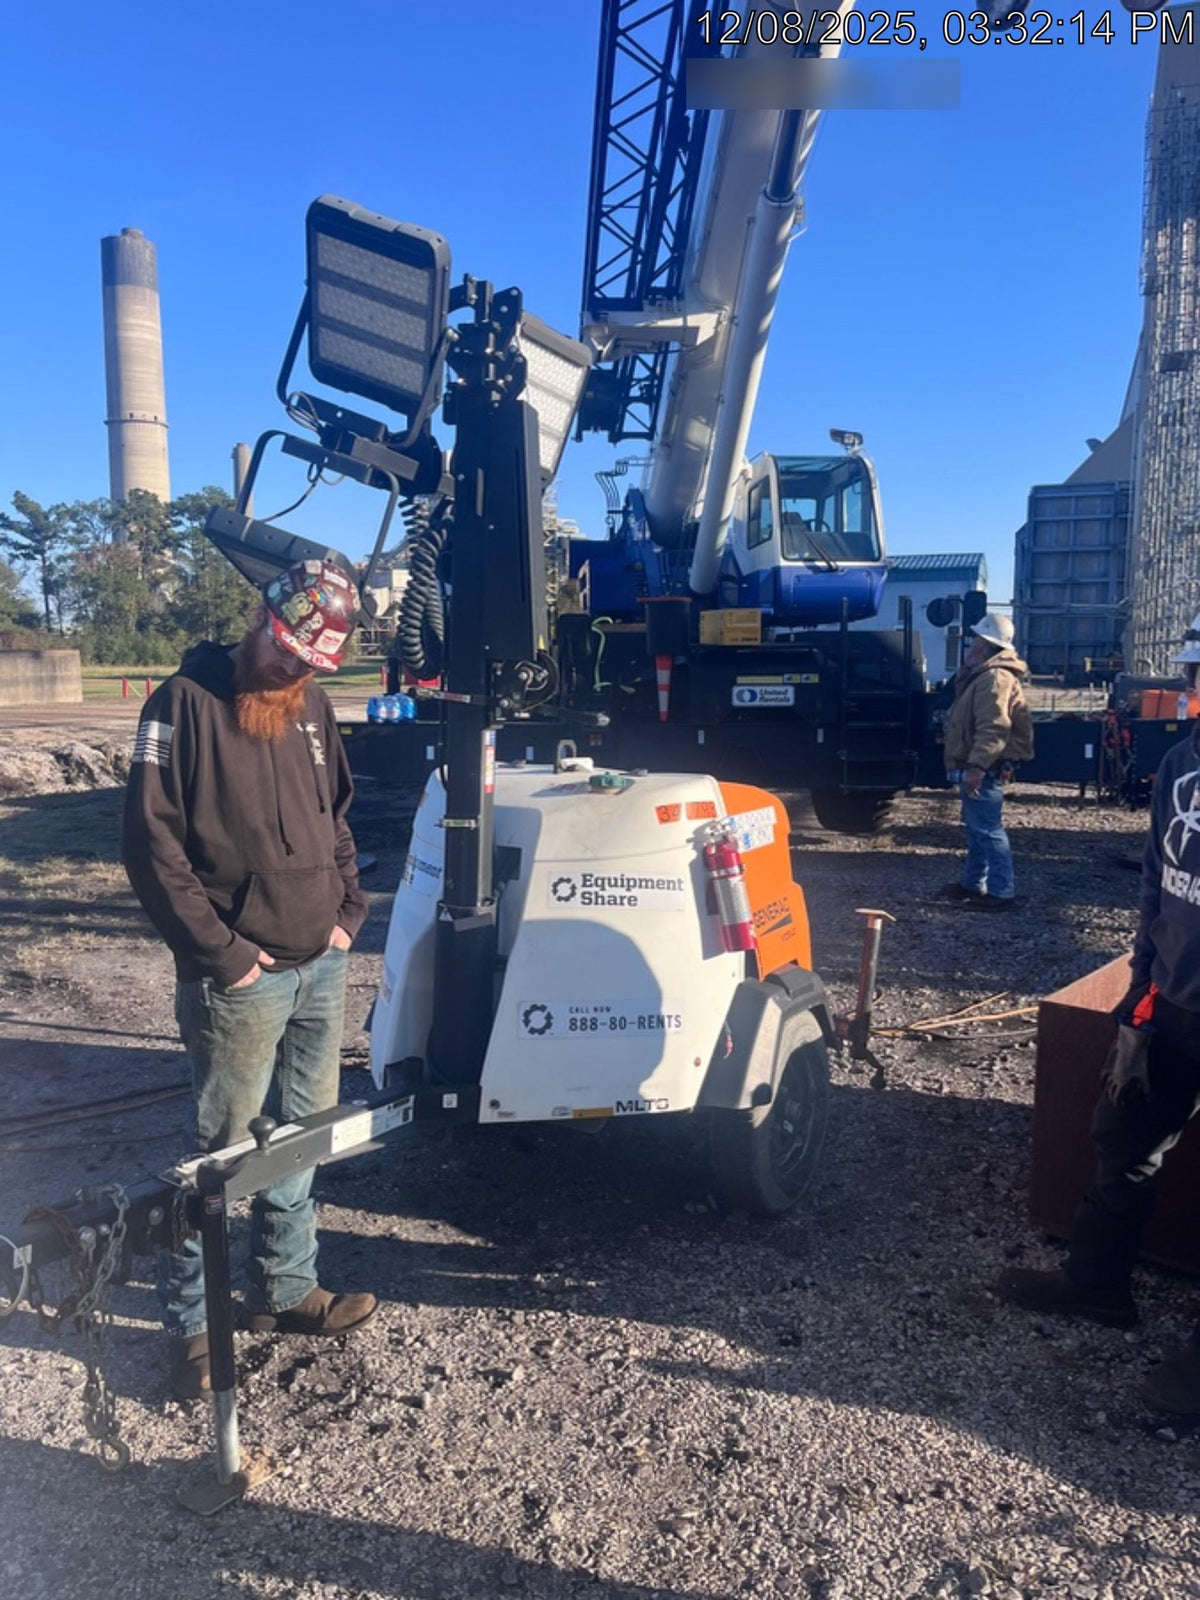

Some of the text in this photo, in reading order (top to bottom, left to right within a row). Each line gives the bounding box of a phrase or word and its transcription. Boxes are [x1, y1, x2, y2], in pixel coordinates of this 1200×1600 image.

[580, 873, 684, 891] Equipment
[580, 891, 638, 907] Share
[569, 1006, 590, 1014] CALL
[568, 1014, 682, 1032] 888-80-RENTS
